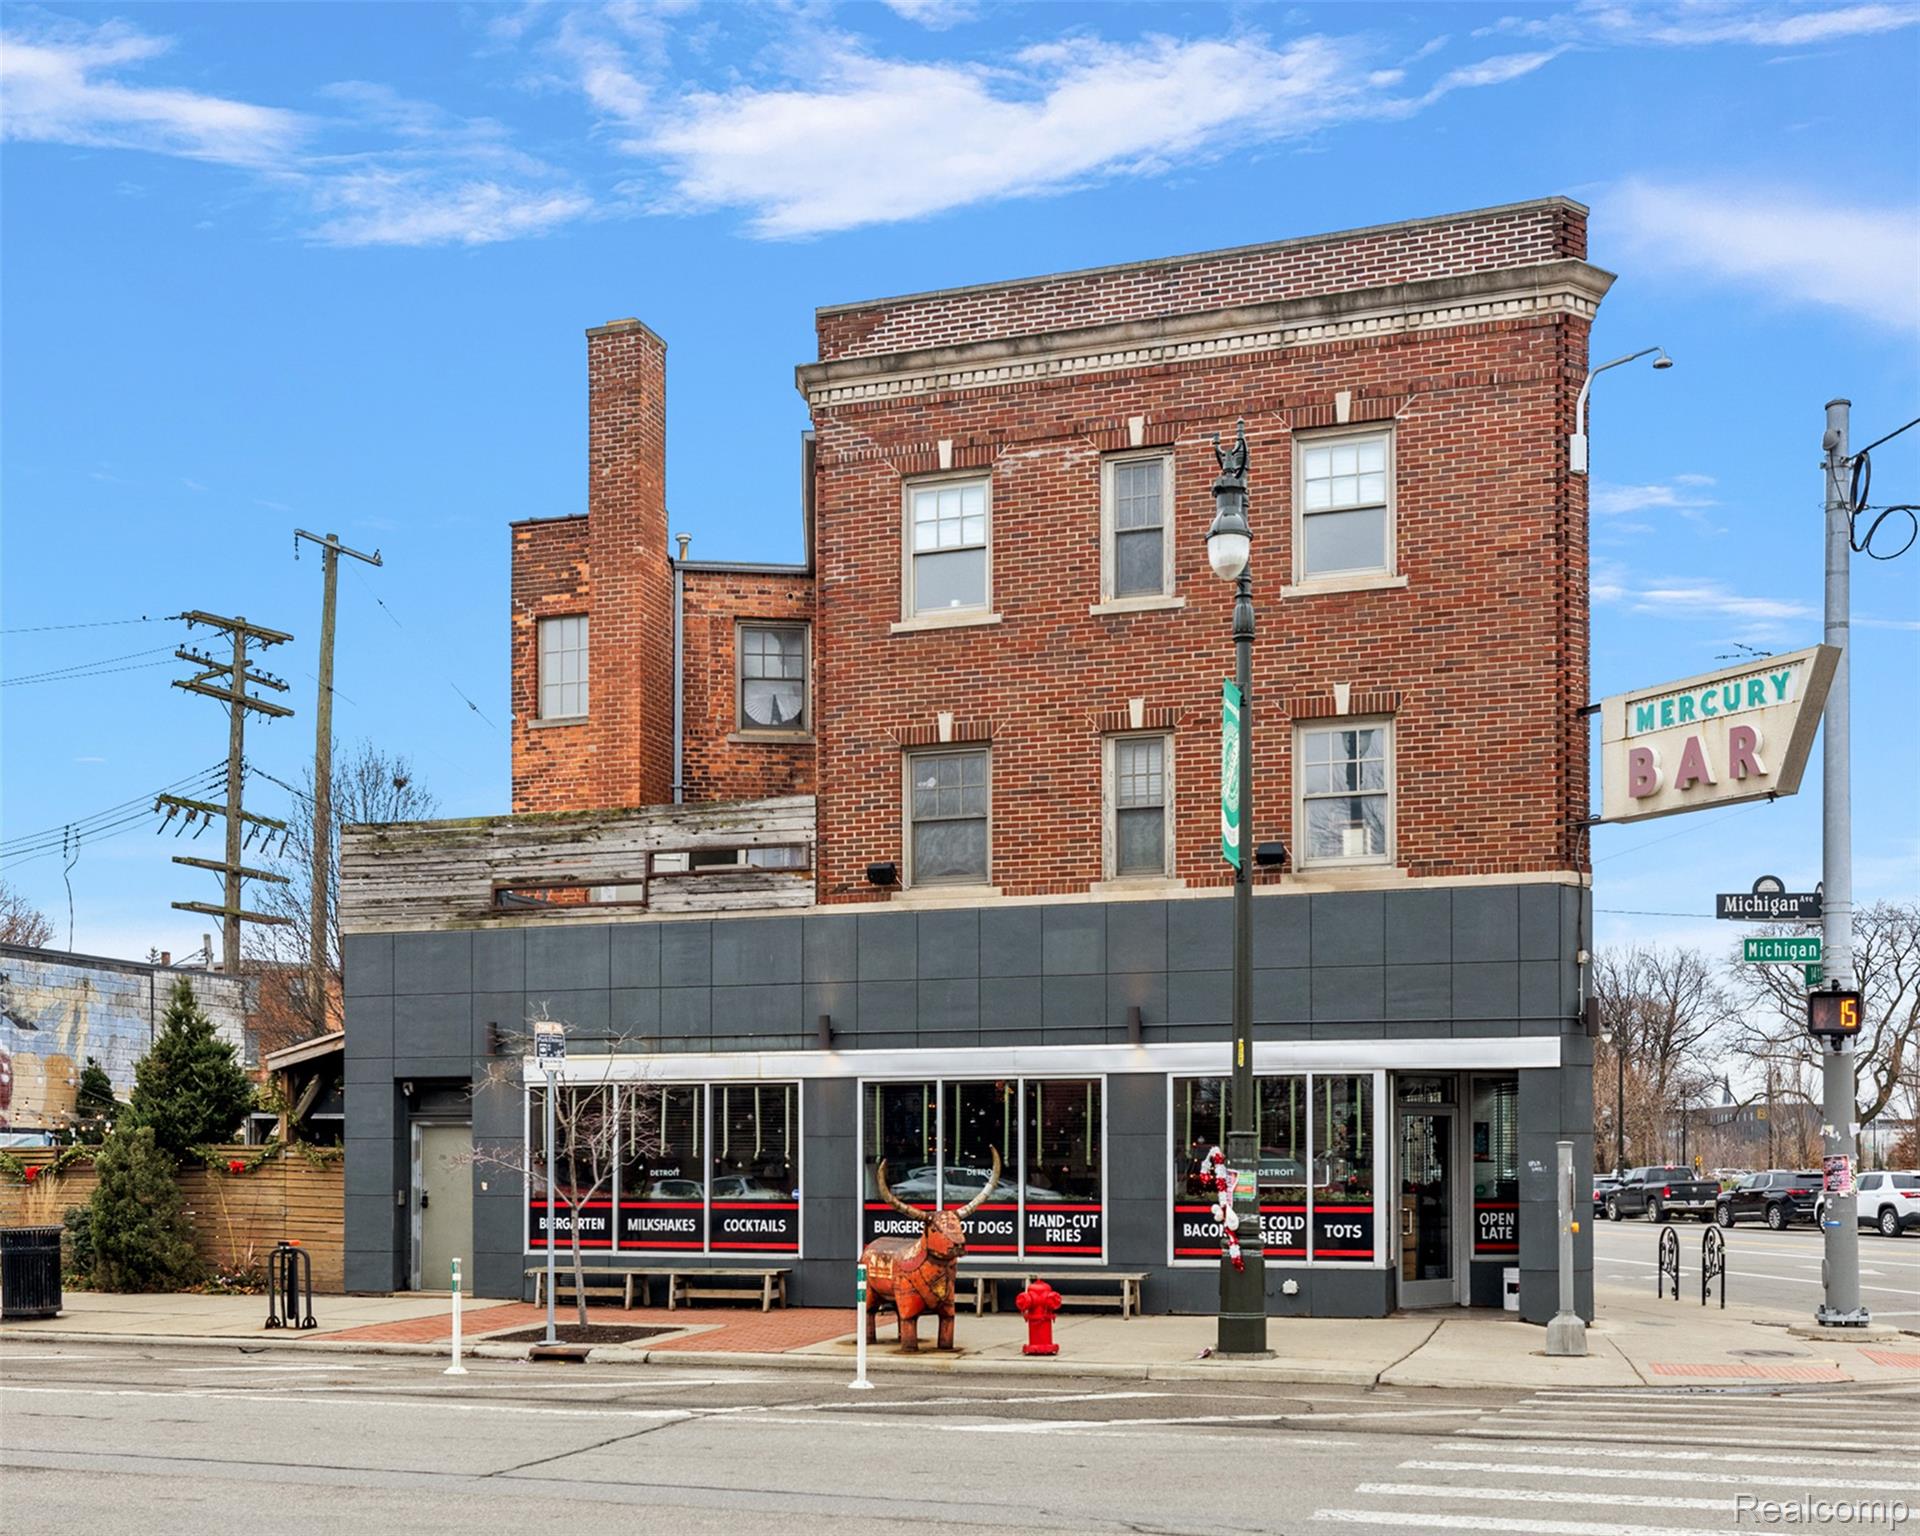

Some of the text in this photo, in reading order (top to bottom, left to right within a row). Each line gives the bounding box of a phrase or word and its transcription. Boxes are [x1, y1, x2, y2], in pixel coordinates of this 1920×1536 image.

[1636, 671, 1790, 732] MERCURY
[1628, 724, 1768, 800] BAR
[1724, 895, 1799, 915] Michigan
[1748, 942, 1817, 960] Michigan
[1840, 999, 1857, 1027] 15
[966, 1168, 993, 1176] DETRO
[1258, 1168, 1295, 1177] DETROIT
[627, 1217, 696, 1232] MILKSHAKES
[723, 1218, 786, 1233] COCKTAILS
[1029, 1214, 1098, 1229] HAND-CUT
[1269, 1216, 1305, 1230] COLD
[1479, 1212, 1515, 1226] OPEN
[874, 1220, 925, 1234] BURGERS
[960, 1221, 1013, 1234] OT DOGS
[1324, 1224, 1363, 1239] TOTS
[1481, 1226, 1513, 1240] LATE
[1045, 1228, 1082, 1243] FRIES
